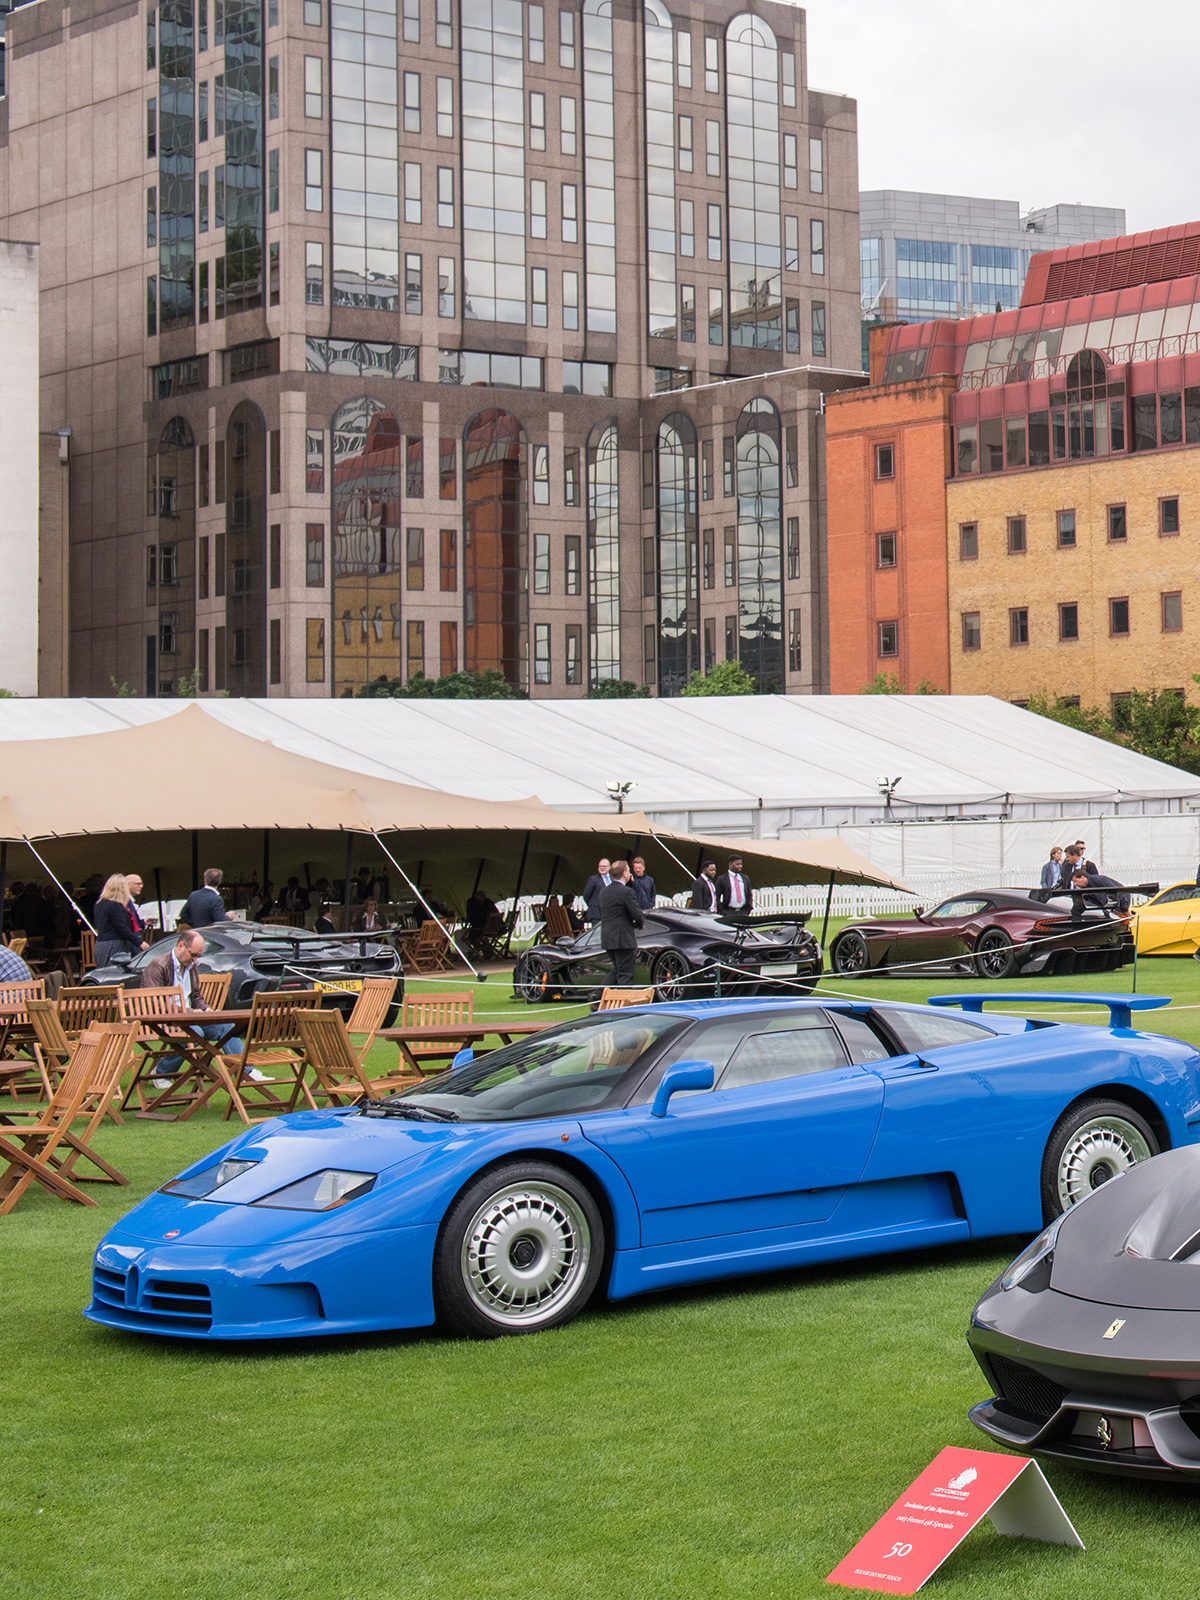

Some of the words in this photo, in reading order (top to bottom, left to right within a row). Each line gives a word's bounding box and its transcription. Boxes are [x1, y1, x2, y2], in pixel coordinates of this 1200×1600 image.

[345, 981, 356, 990] HS
[944, 1489, 970, 1497] CONCOURS
[907, 1516, 925, 1524] Ferrari
[932, 1521, 954, 1529] Speciale
[883, 1542, 912, 1558] 50
